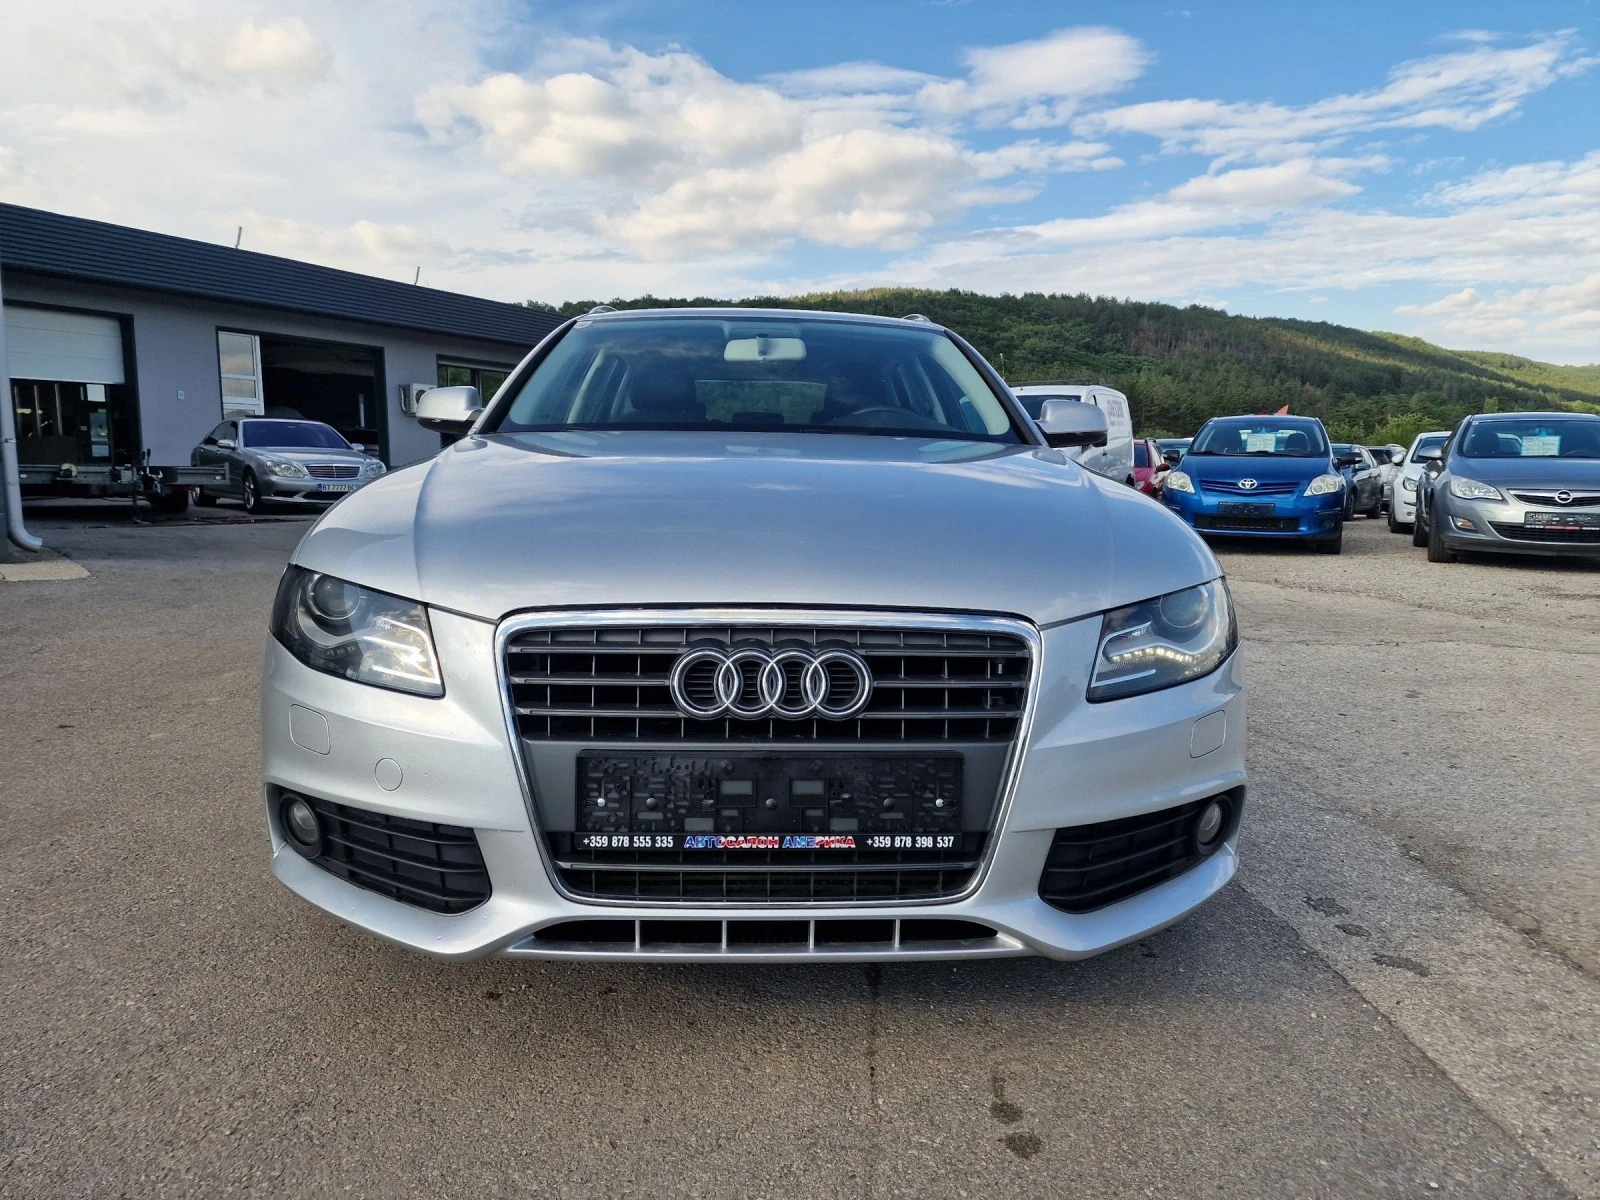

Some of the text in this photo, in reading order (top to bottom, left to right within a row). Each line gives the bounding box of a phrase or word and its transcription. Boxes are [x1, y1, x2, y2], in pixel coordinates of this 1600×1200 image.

[583, 836, 674, 848] +359 878 555 335
[684, 836, 856, 848] АВТОСАЛОН АМЕРИКА
[866, 836, 954, 848] +359 878 398 537
